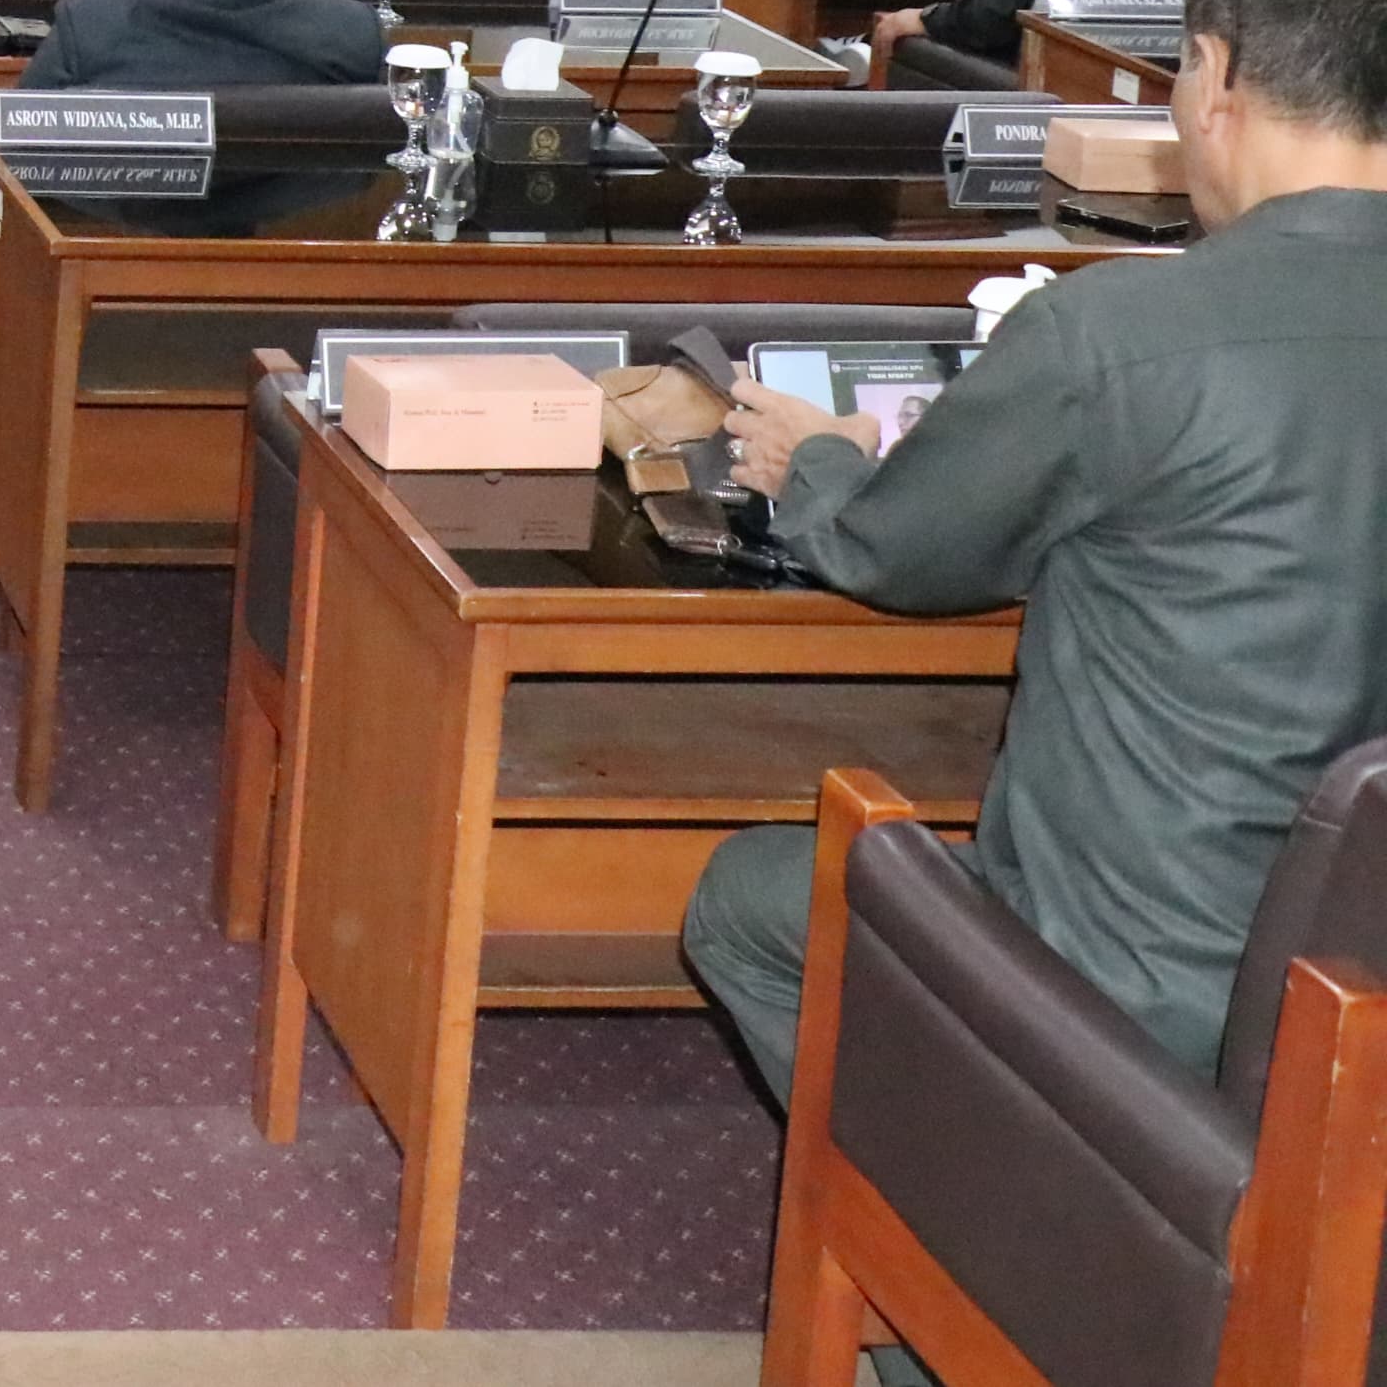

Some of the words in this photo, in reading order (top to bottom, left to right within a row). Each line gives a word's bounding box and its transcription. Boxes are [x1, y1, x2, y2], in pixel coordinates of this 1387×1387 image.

[6, 110, 58, 127] ASRO'IN
[64, 112, 127, 131] WIDYANA,
[166, 113, 203, 129] M.H.P.
